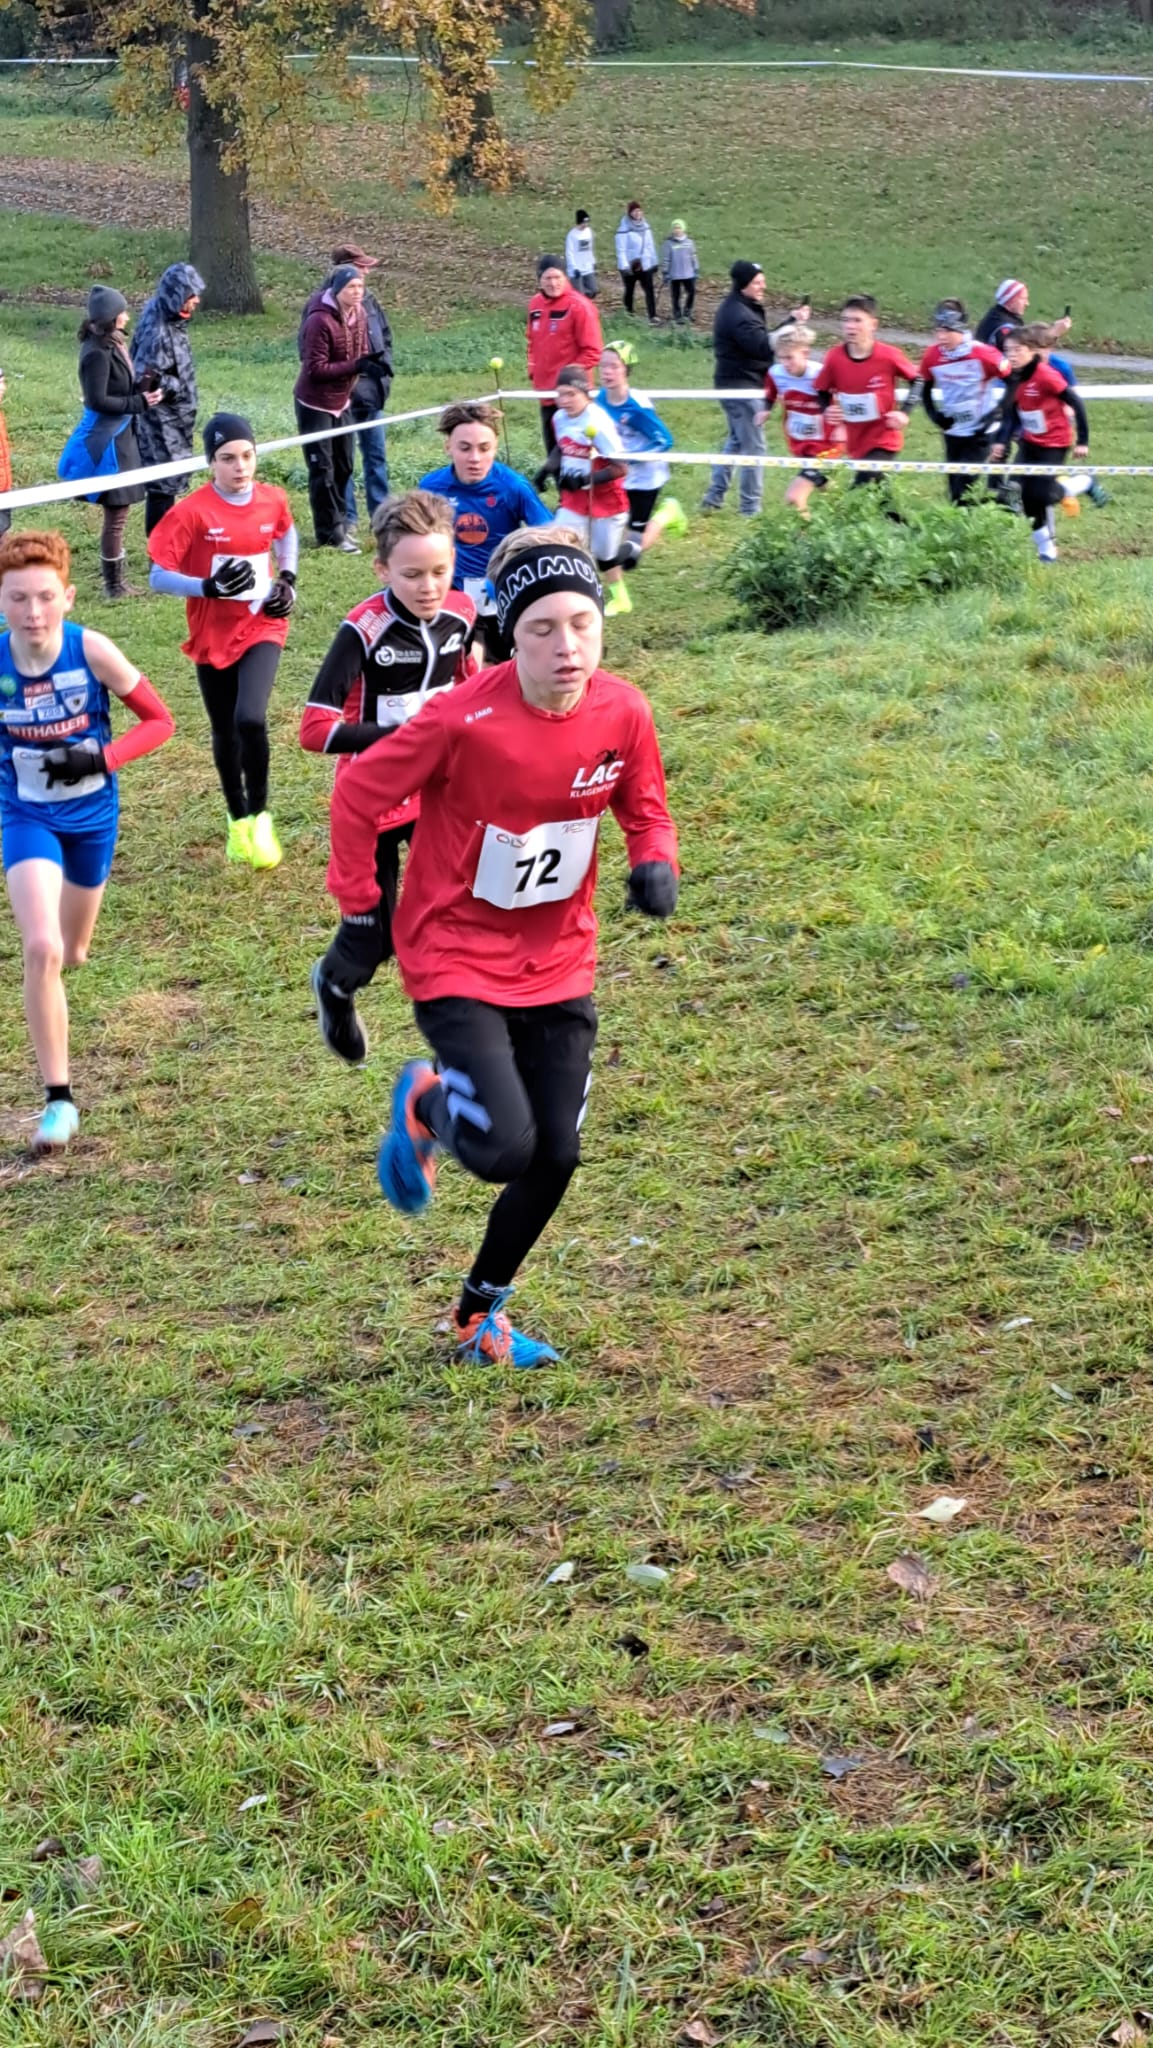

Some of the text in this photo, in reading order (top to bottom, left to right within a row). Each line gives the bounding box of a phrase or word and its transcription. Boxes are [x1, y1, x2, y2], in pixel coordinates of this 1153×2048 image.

[497, 556, 602, 635] AMMUT
[569, 781, 616, 799] KLAGENFUR
[571, 760, 625, 789] LAC
[514, 849, 562, 893] 72
